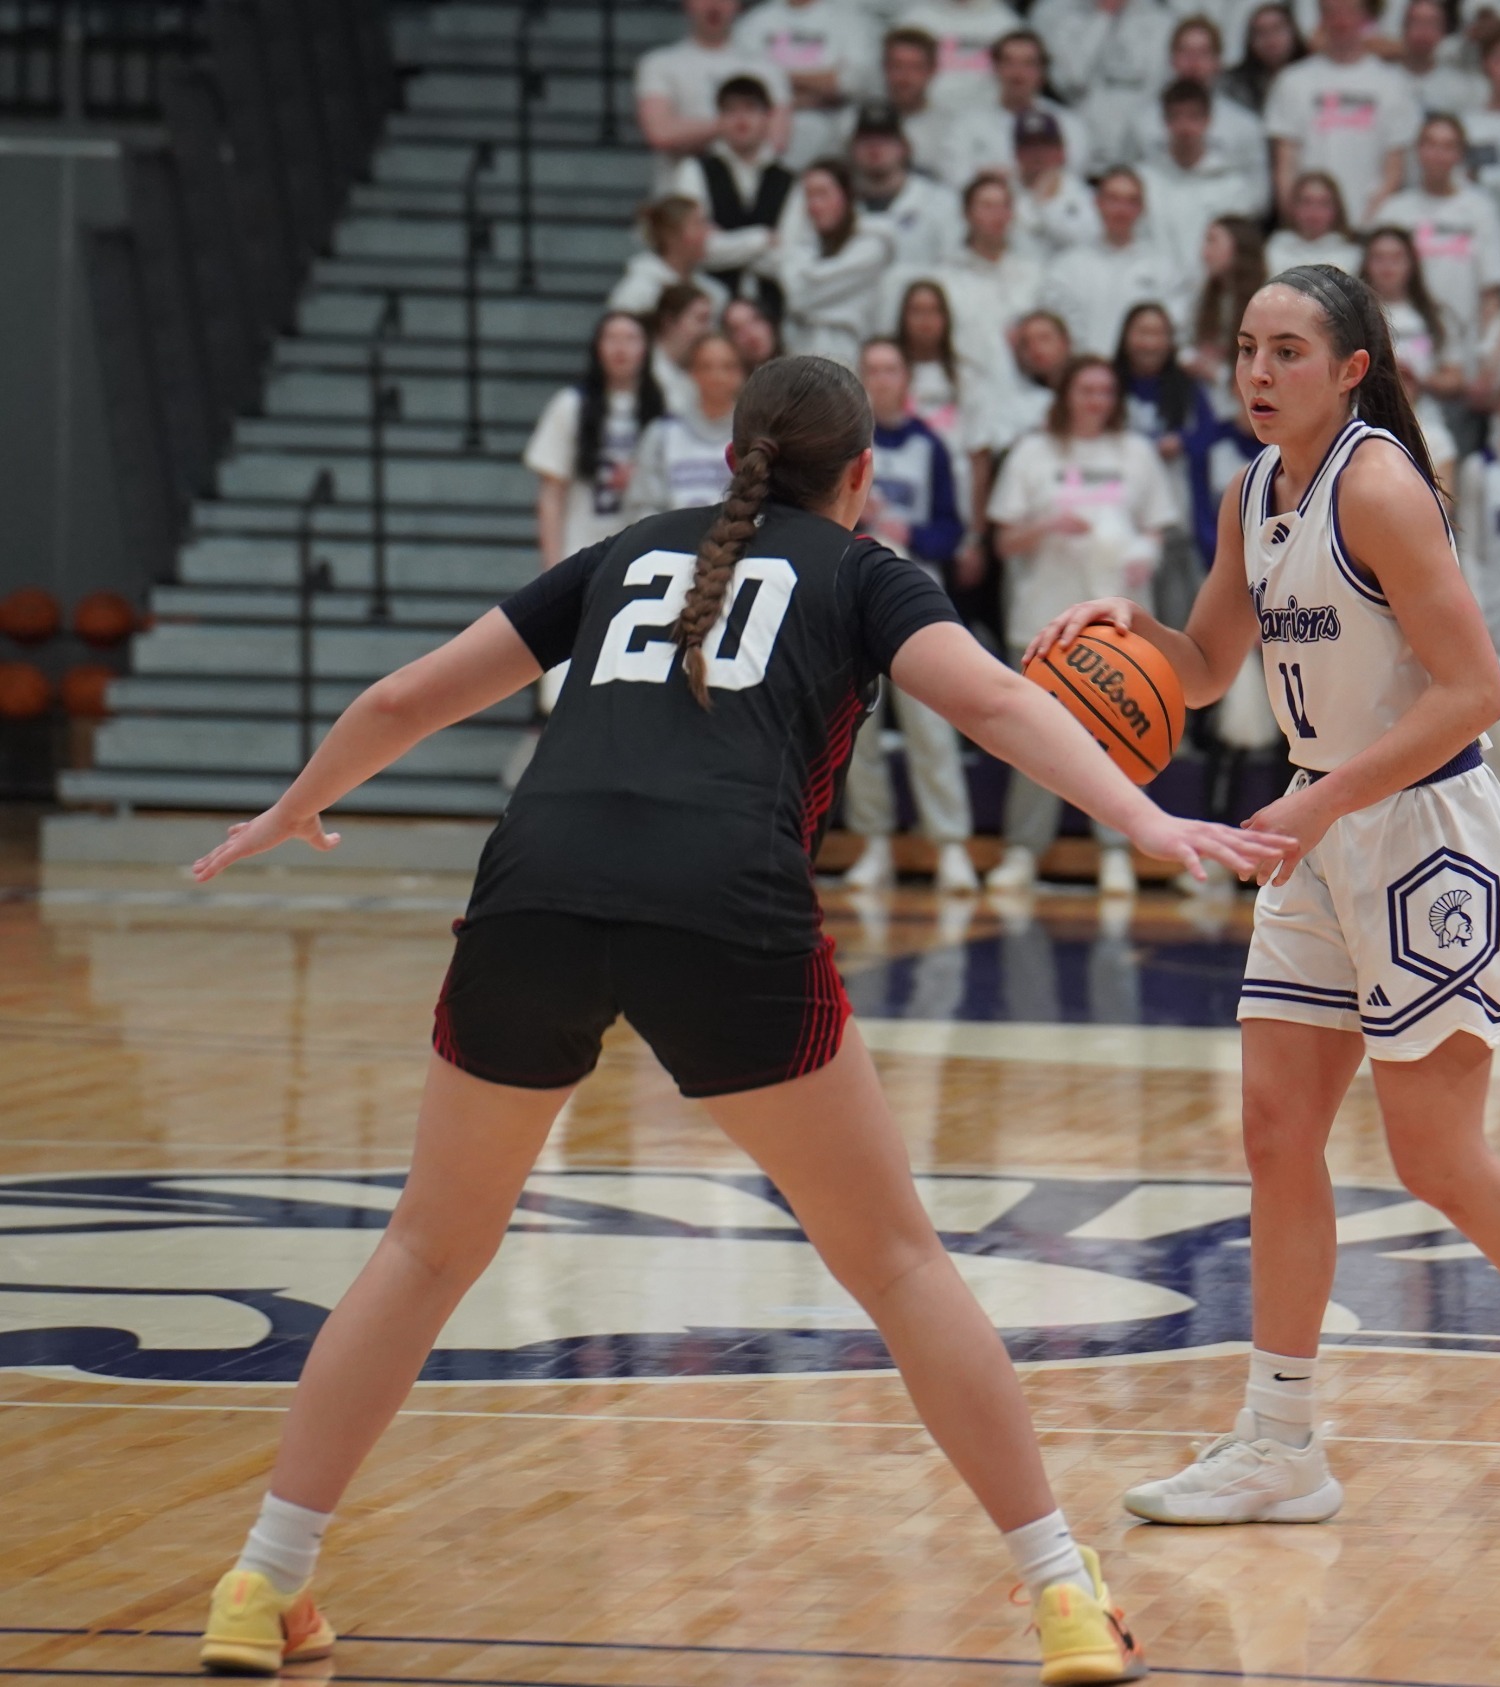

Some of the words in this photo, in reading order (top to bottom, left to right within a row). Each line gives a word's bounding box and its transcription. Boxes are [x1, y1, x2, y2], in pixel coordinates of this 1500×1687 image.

[591, 549, 798, 692] 20
[1066, 644, 1151, 739] Wilson
[1279, 663, 1317, 738] 11
